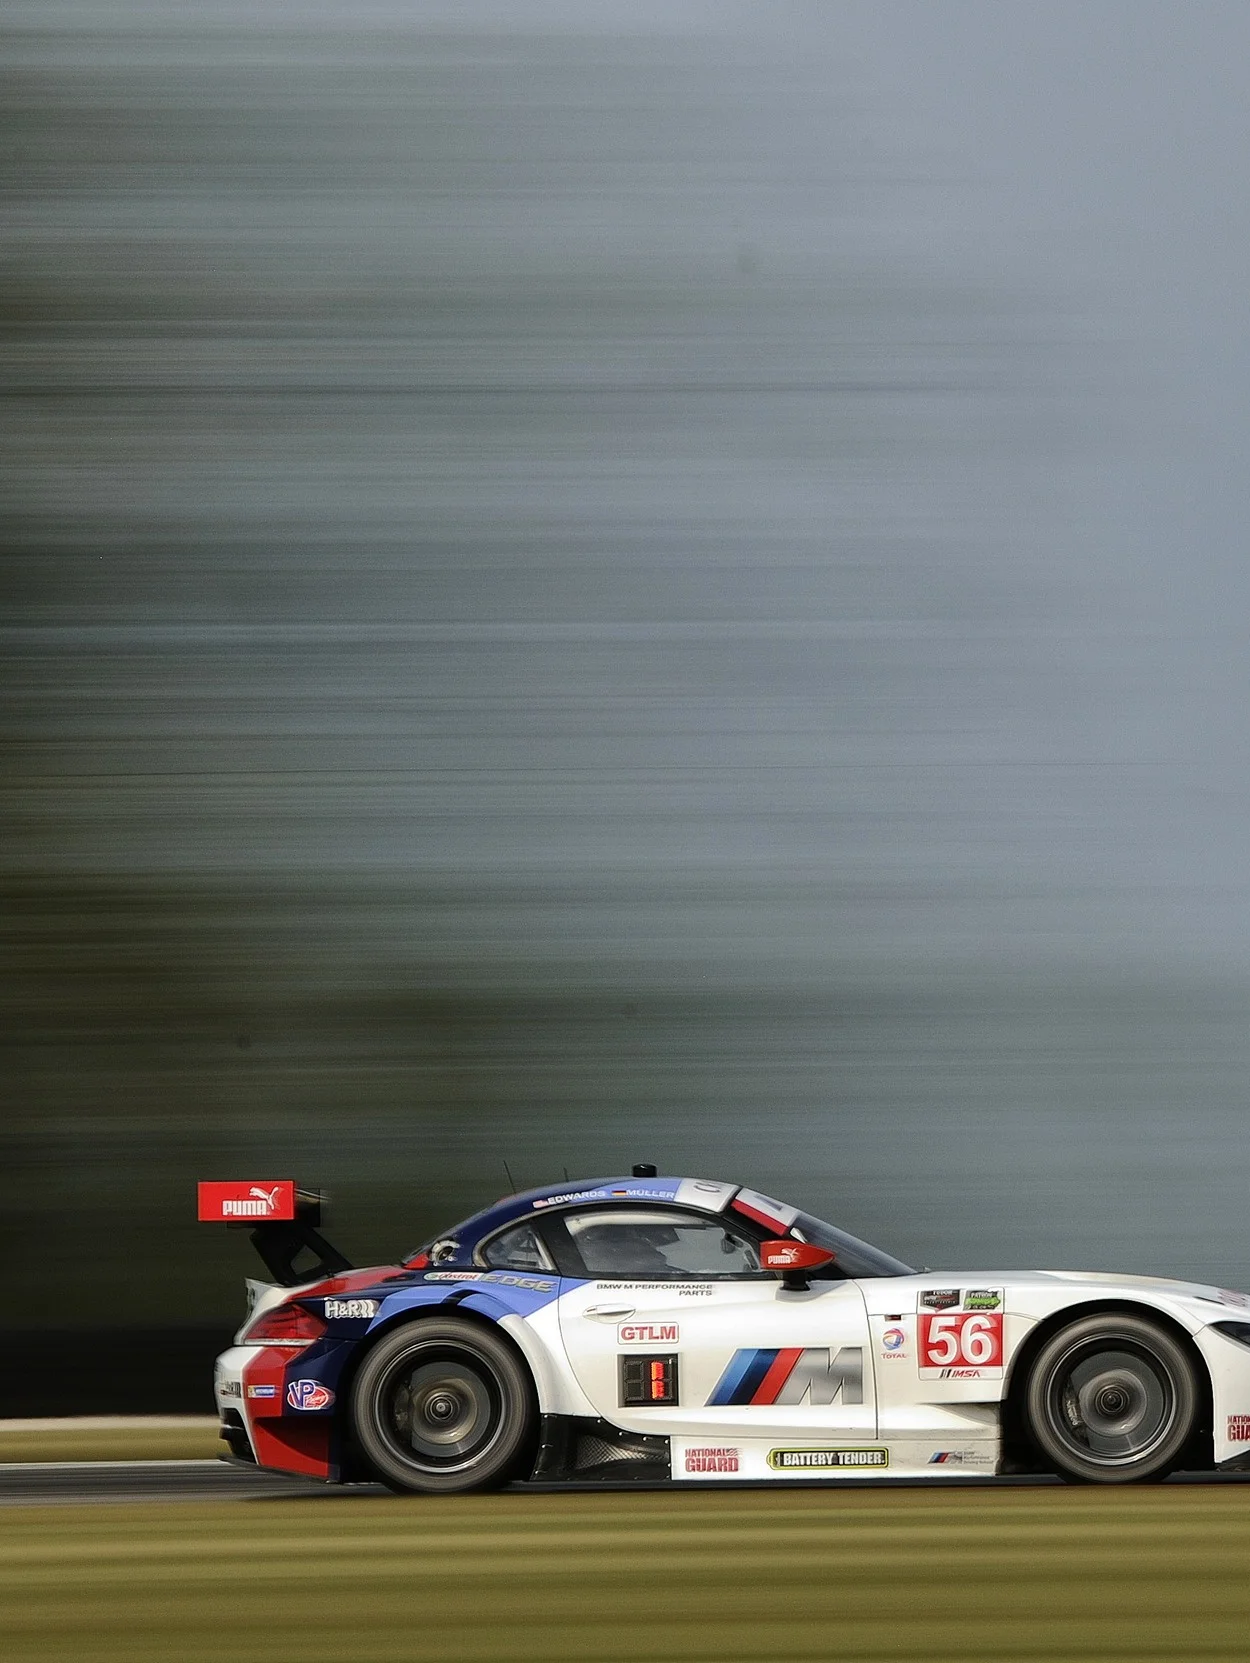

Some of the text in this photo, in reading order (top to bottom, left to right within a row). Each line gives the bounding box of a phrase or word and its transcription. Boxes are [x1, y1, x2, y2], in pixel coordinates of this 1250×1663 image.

[548, 1189, 675, 1205] EDWARDS MÜLLER
[222, 1200, 267, 1216] PUMA
[767, 1255, 791, 1265] PUMA
[481, 1274, 557, 1293] EDGE
[621, 1326, 677, 1341] GTLM
[927, 1315, 993, 1365] 56
[951, 1369, 981, 1378] IMSA
[685, 1448, 726, 1457] NATIONAL
[783, 1452, 834, 1466] BATTERY
[685, 1457, 739, 1472] GUARD
